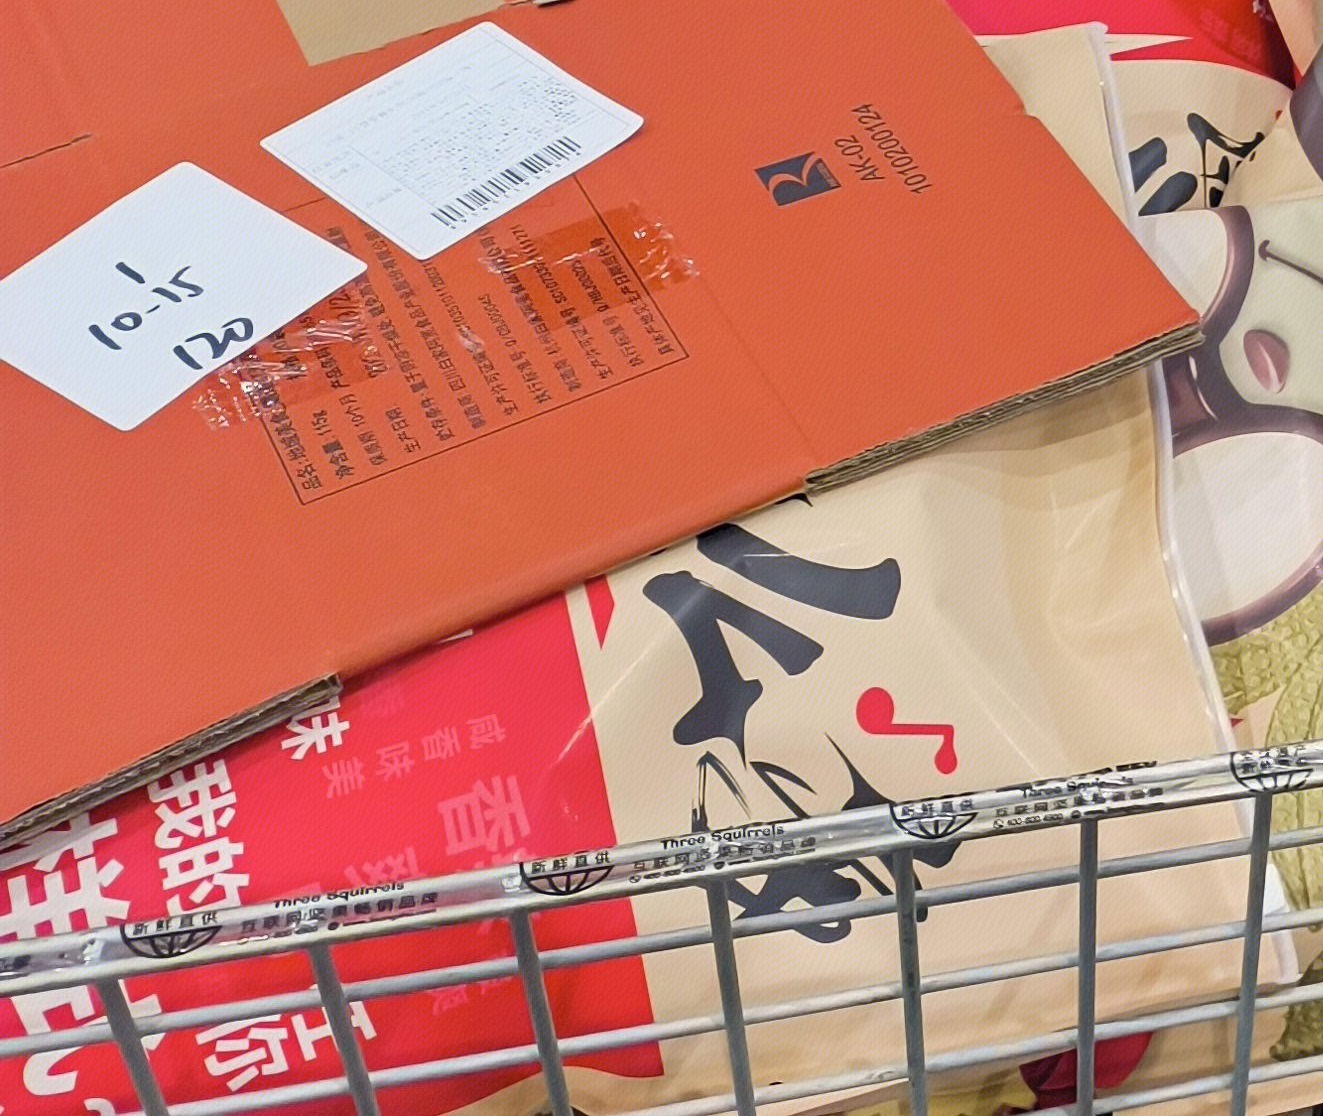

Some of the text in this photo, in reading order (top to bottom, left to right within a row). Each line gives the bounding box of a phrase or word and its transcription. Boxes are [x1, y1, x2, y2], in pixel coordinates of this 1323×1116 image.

[834, 135, 885, 183] AK-02
[851, 102, 933, 196] 1010200124
[114, 261, 145, 284] 1
[87, 264, 204, 350] 10-15
[172, 316, 255, 370] 120
[660, 820, 785, 851] Three Squirrels
